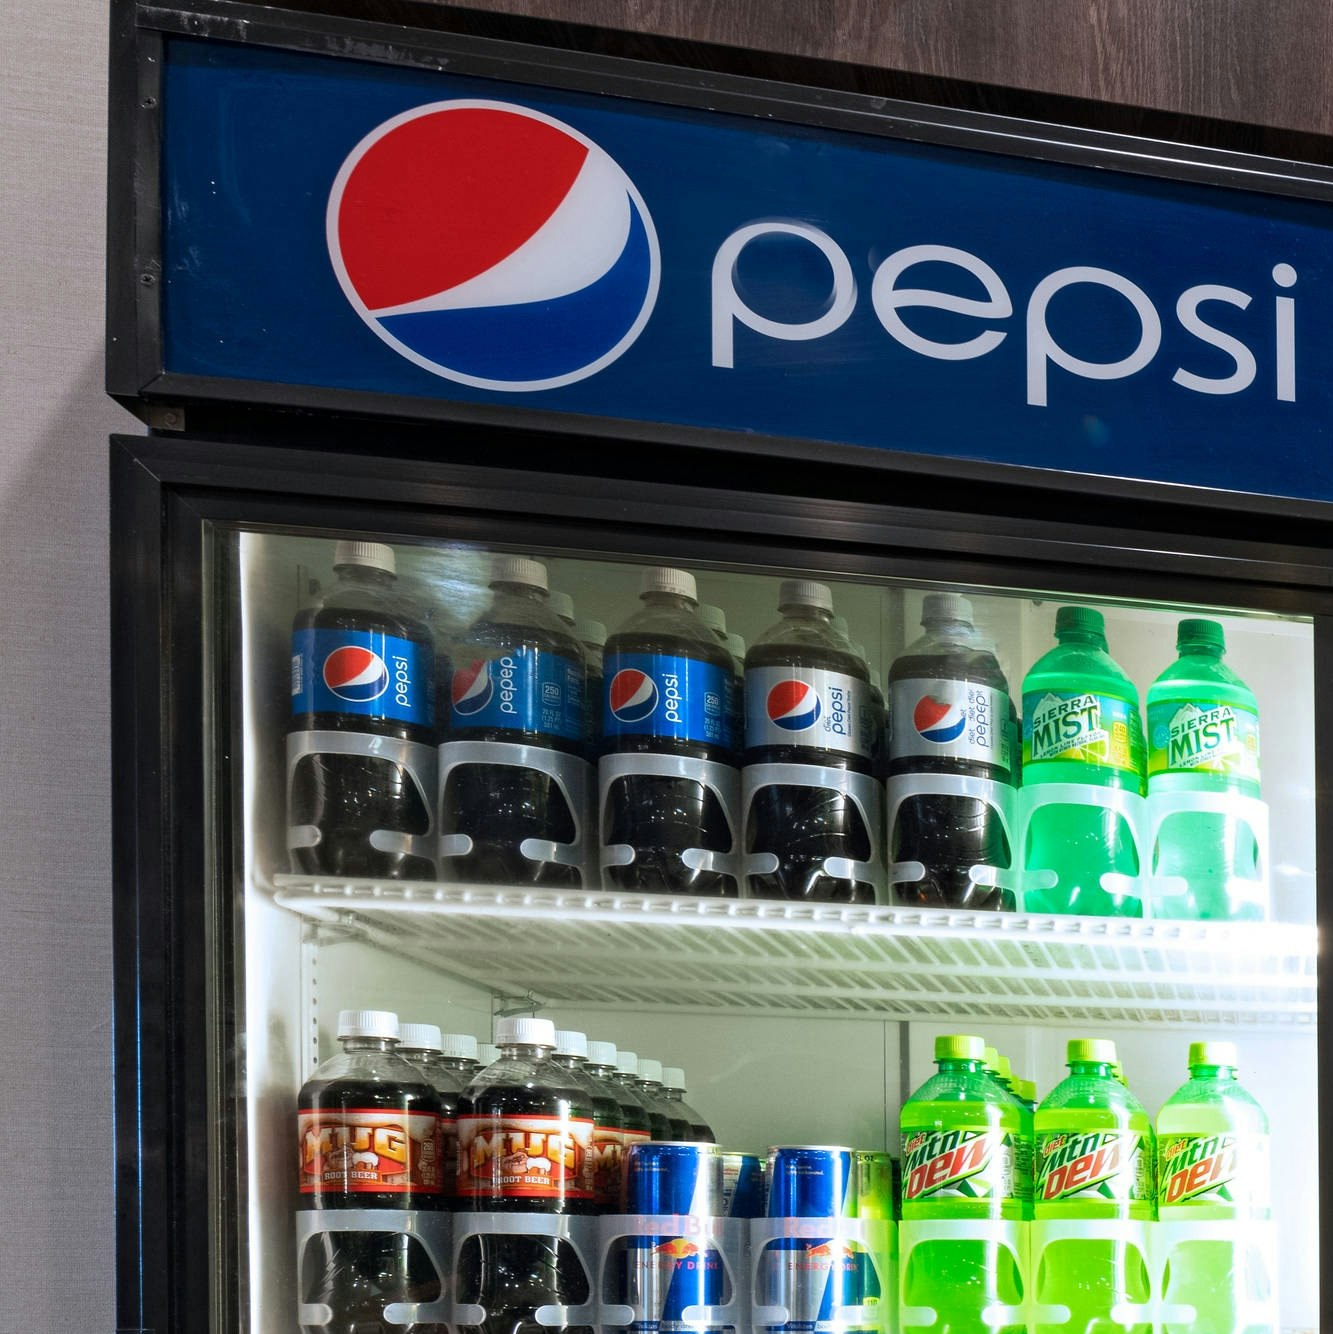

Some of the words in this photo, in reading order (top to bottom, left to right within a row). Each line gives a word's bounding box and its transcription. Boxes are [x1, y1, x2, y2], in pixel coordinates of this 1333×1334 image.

[711, 221, 1298, 407] pepsi
[393, 654, 409, 707] pepsi
[661, 672, 682, 723] pepsi
[828, 686, 846, 735] pepsi
[1033, 705, 1098, 757] MIST
[1034, 695, 1094, 728] SIERRA
[1171, 707, 1231, 738] SIERRA
[1170, 717, 1235, 767] MIST
[302, 1126, 409, 1170] MUG
[472, 1127, 581, 1169] MUG
[906, 1131, 960, 1172] Mtn
[907, 1134, 926, 1151] diet
[1044, 1136, 1066, 1157] diet
[1045, 1133, 1111, 1175] Mtn
[1166, 1136, 1218, 1177] Mtn
[323, 1170, 348, 1181] ROOT
[350, 1169, 379, 1181] BEER
[525, 1175, 551, 1186] BEER
